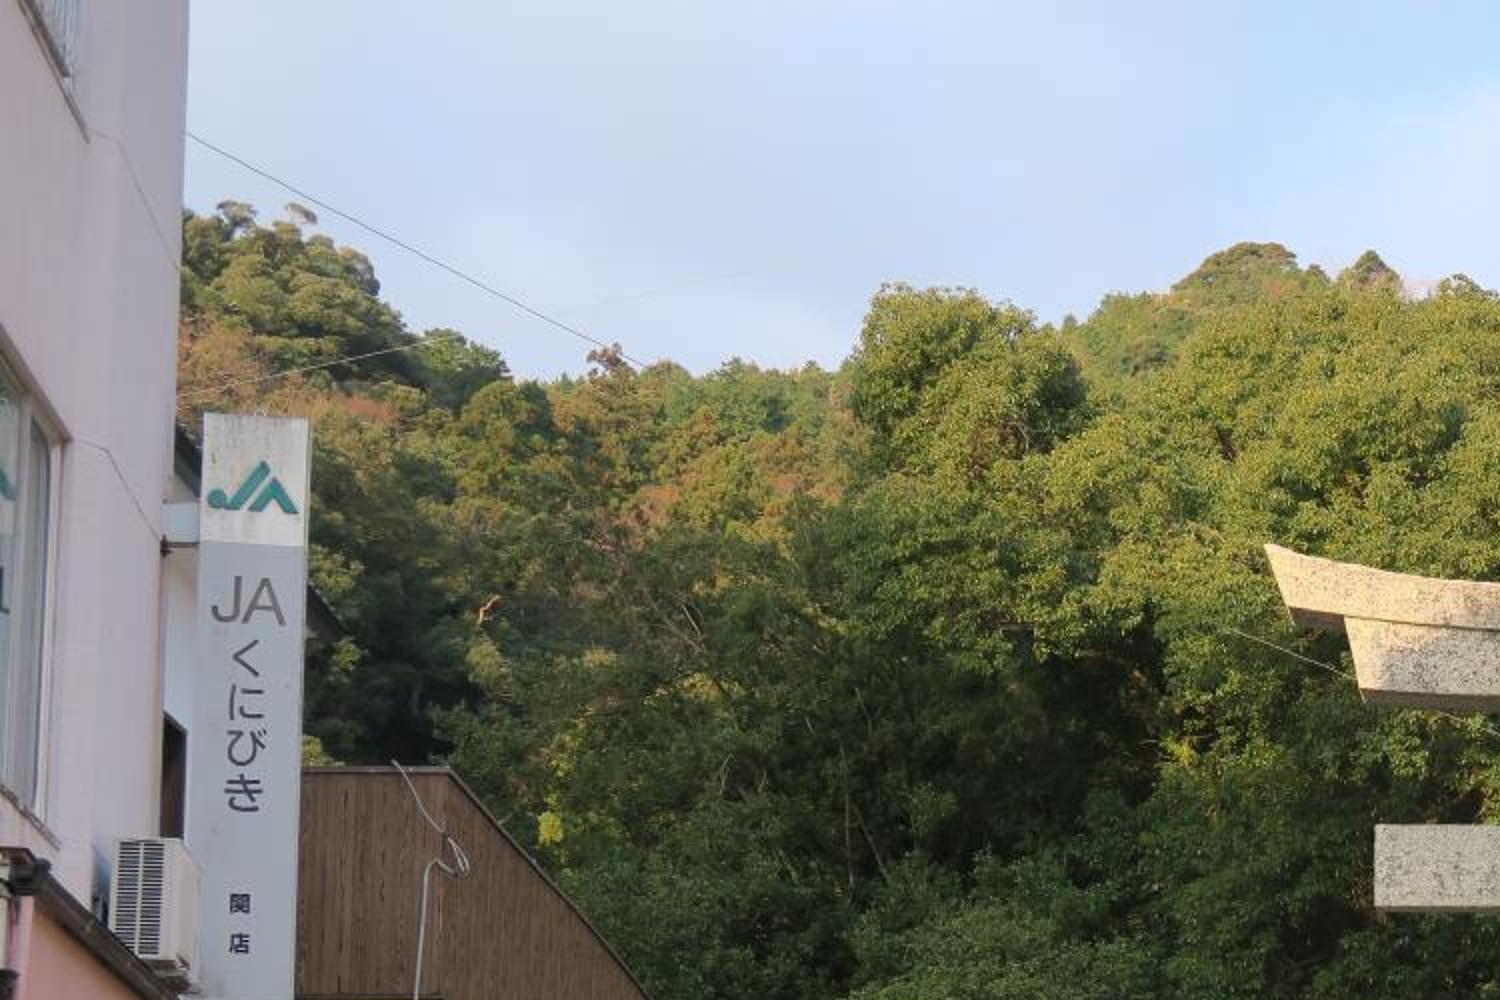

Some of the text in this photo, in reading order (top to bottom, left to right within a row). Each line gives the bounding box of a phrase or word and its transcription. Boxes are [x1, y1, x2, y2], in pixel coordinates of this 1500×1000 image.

[211, 575, 287, 813] JA くにびき
